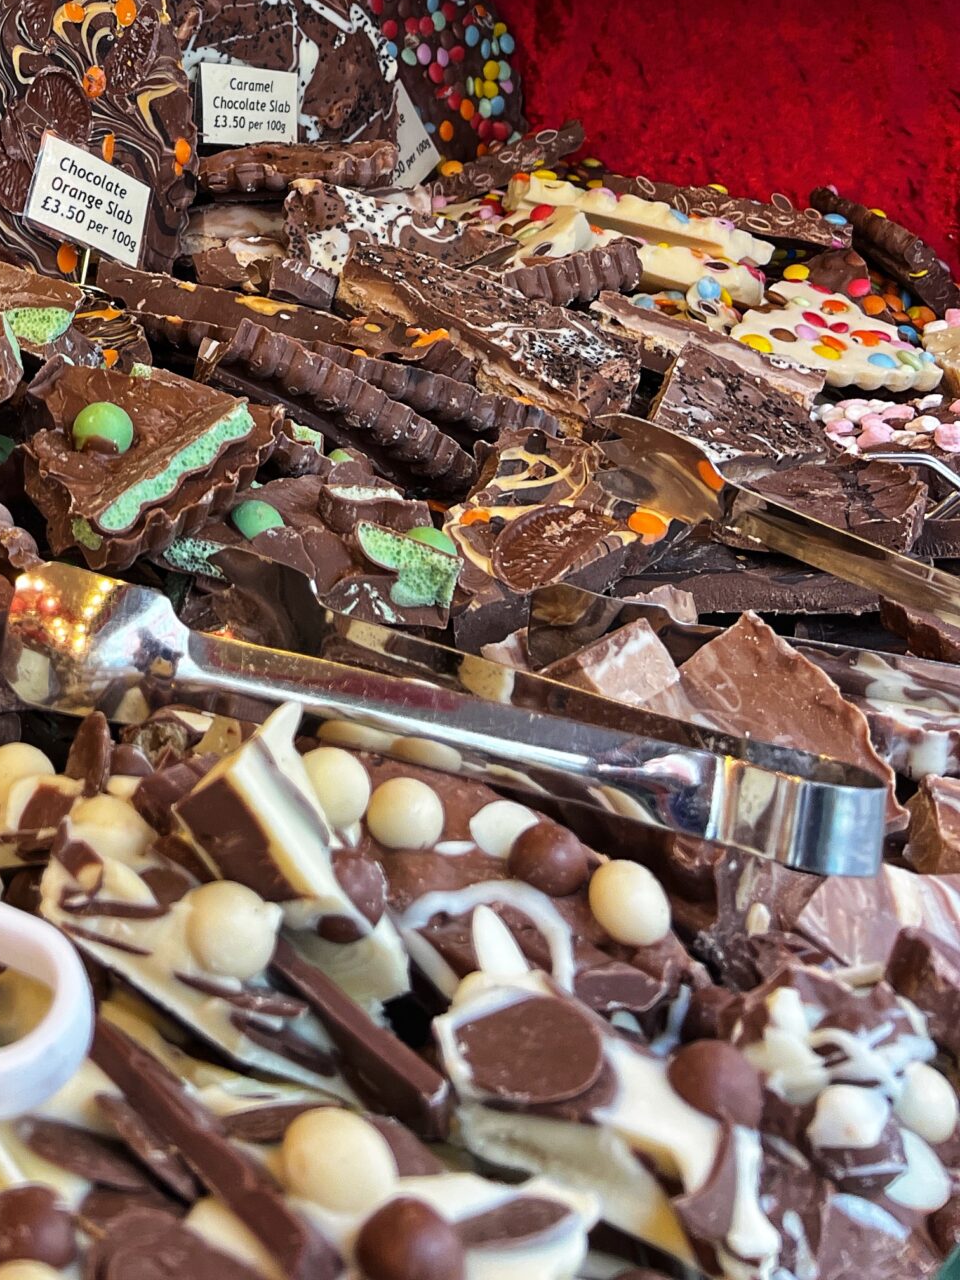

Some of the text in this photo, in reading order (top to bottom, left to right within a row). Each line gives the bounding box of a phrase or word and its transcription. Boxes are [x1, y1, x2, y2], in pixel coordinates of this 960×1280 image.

[229, 77, 274, 93] Caramel
[212, 96, 291, 113] Chocolate Slab
[213, 115, 286, 134] £3.50 per 100g
[59, 156, 128, 200] Chocolate
[51, 176, 133, 225] Orange Slab
[40, 195, 137, 253] £3.50 per 100g
